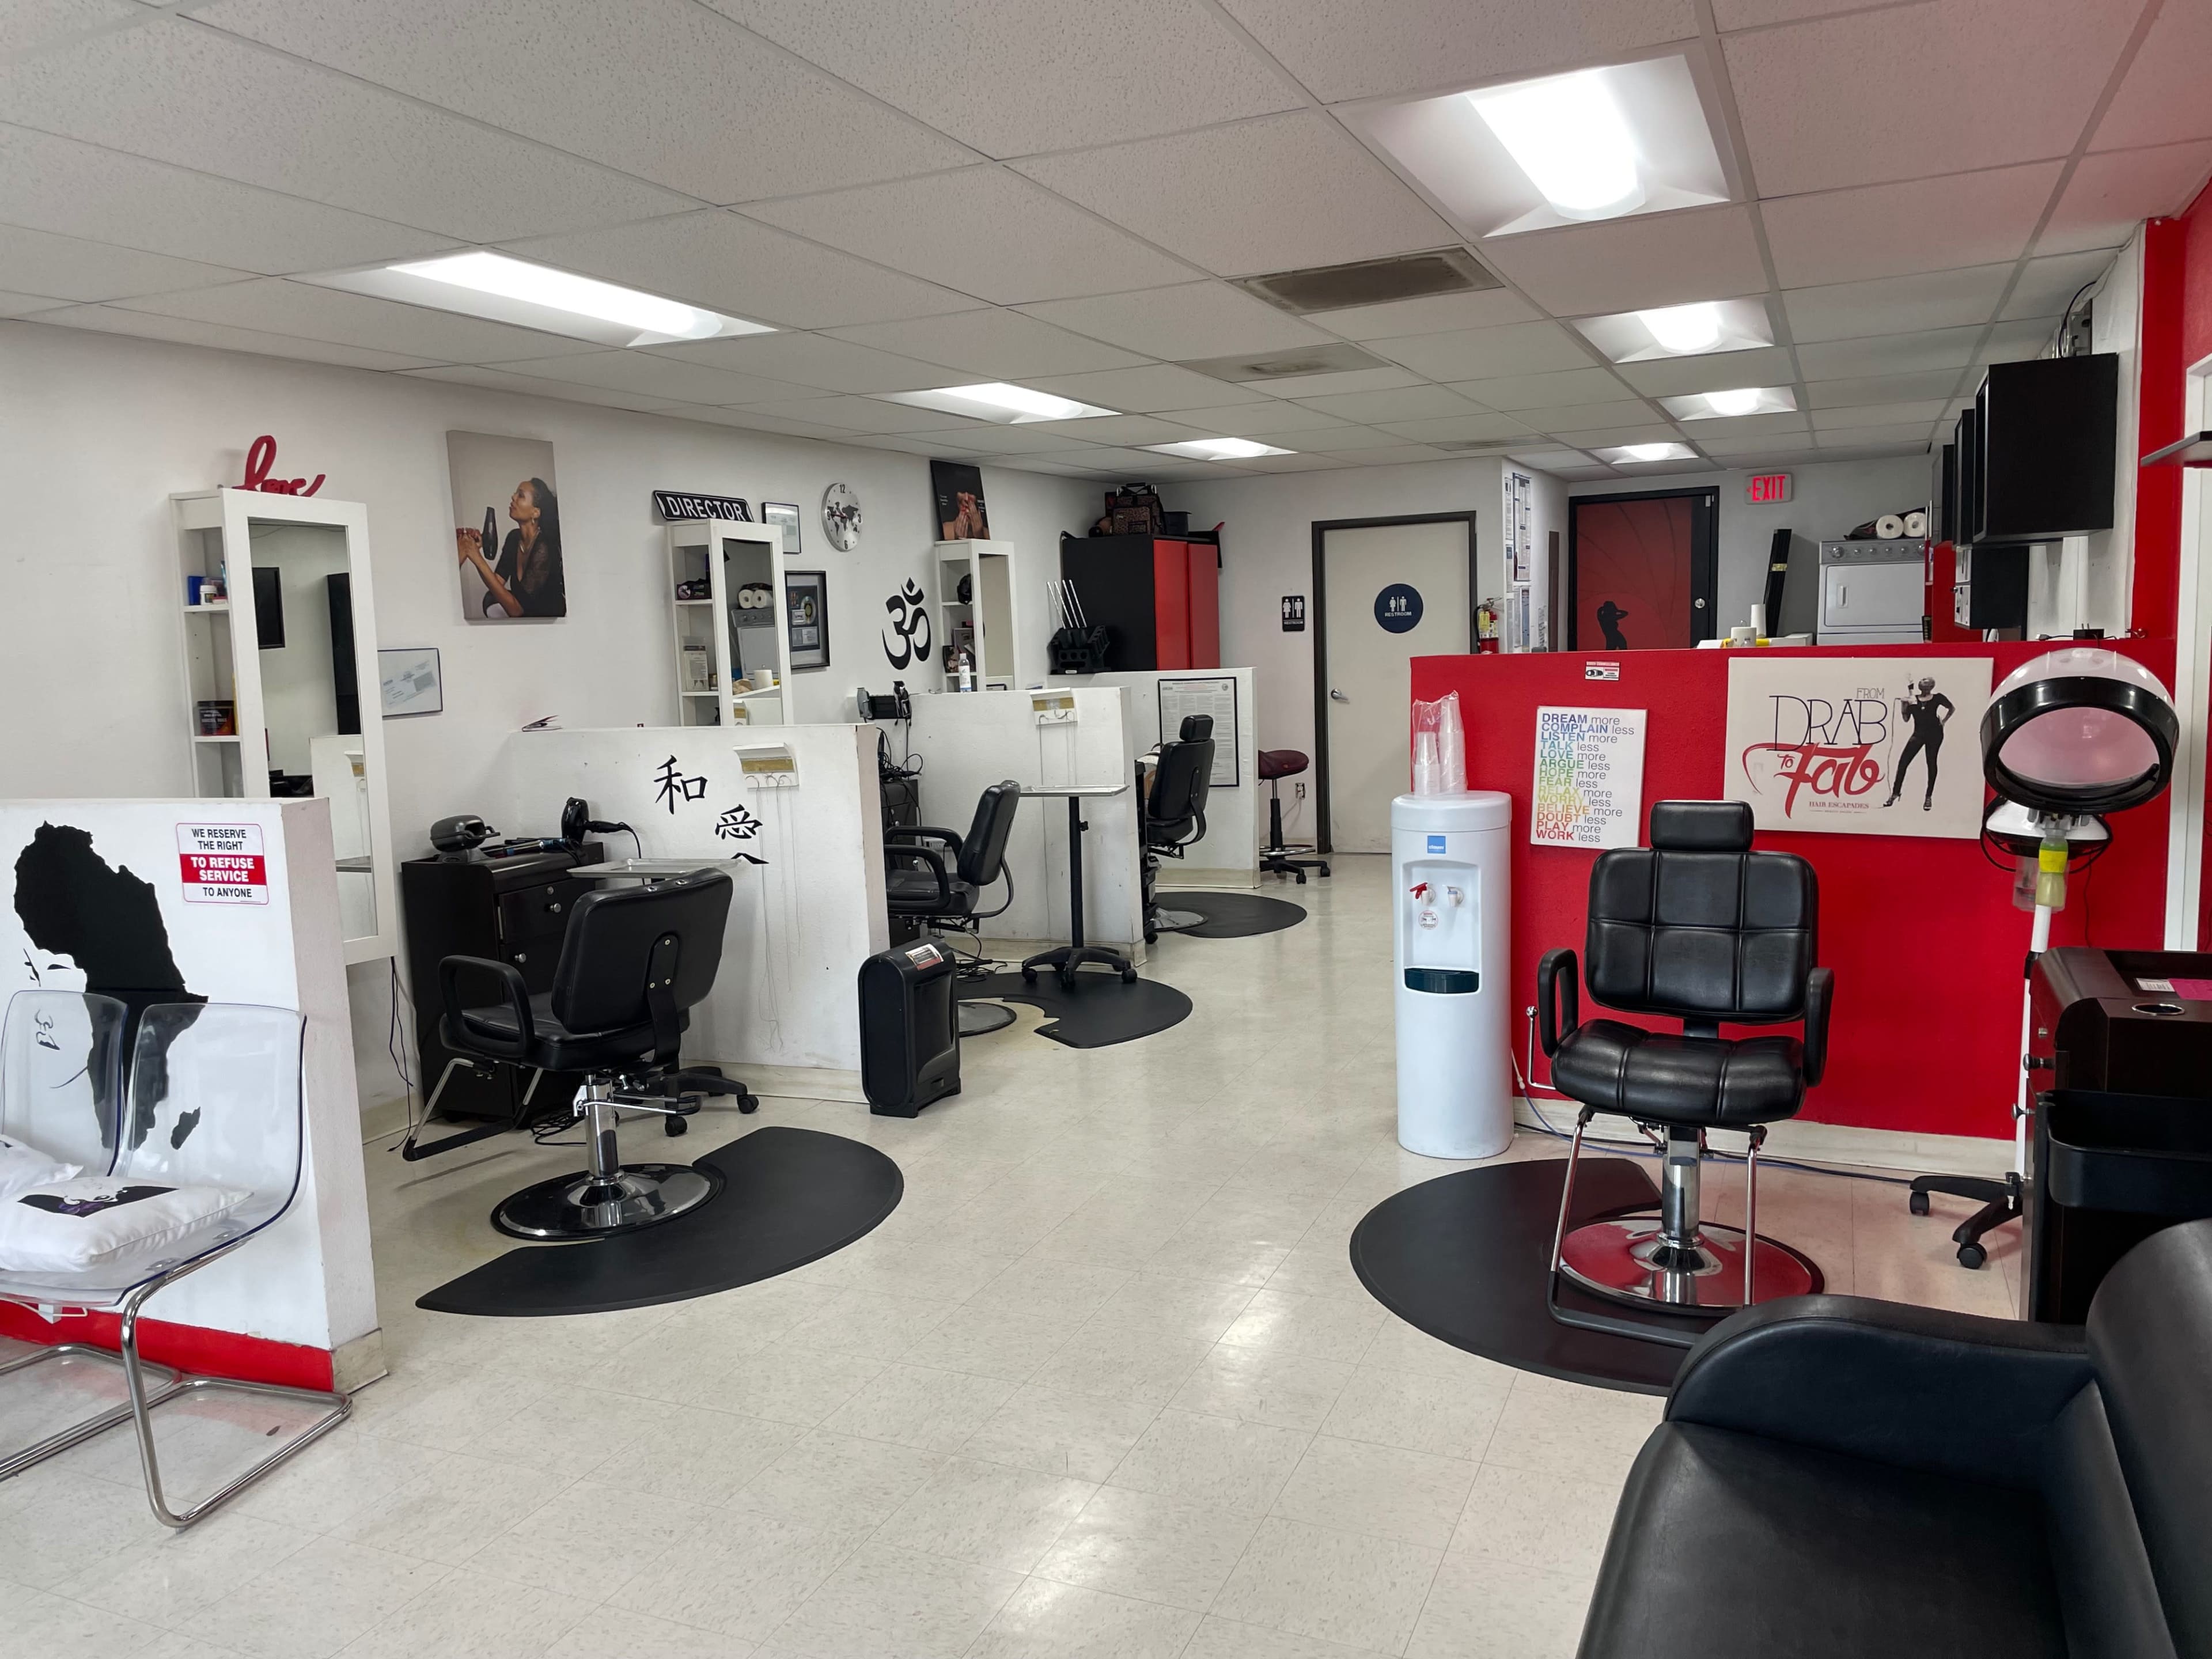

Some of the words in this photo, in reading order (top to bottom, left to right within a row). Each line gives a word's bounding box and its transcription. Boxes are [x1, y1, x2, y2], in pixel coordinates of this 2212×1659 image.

[840, 484, 846, 493] 12
[1752, 474, 1786, 501] EXIT
[666, 497, 746, 521] DIRECTOR
[858, 514, 862, 523] 3
[844, 540, 848, 550] 6
[1856, 688, 1885, 699] FROM
[1542, 713, 1587, 724] DREAM
[1591, 717, 1620, 725] more
[1766, 695, 1888, 751] DRAB
[1541, 723, 1608, 733] COMPLAIN
[1612, 725, 1634, 734] less
[1541, 732, 1585, 741] LISTEN
[1589, 735, 1618, 743] more
[1541, 741, 1573, 749] TALK
[1577, 743, 1599, 752] less
[1540, 749, 1573, 759] LOVE
[1577, 753, 1605, 761] more
[1539, 759, 1584, 769] ARGUE
[1588, 760, 1610, 770] less
[1539, 768, 1574, 777] HOPE
[1577, 771, 1606, 779] more
[1539, 777, 1571, 786] FEAR
[1576, 778, 1598, 788] less
[1742, 741, 1885, 819] Fab
[1539, 786, 1580, 796] RELAX
[1584, 790, 1612, 798] more
[1538, 794, 1584, 805] WORRY
[1589, 797, 1611, 806] less
[1537, 803, 1590, 815] BELIEVE
[1594, 808, 1622, 817] more
[1537, 812, 1581, 823] DOUBT
[1585, 815, 1606, 825] less
[191, 828, 206, 838] WE
[207, 829, 247, 838] RESERVE
[1536, 821, 1569, 831] PLAY
[1573, 825, 1601, 833] more
[1536, 830, 1574, 840] WORK
[1578, 832, 1600, 843] less
[198, 841, 215, 850] THE
[217, 841, 243, 850] RIGHT
[191, 857, 207, 868] TO
[209, 857, 255, 869] REFUSE
[199, 870, 249, 882] SERVICE
[203, 887, 214, 896] TO
[217, 888, 252, 897] ANYONE
